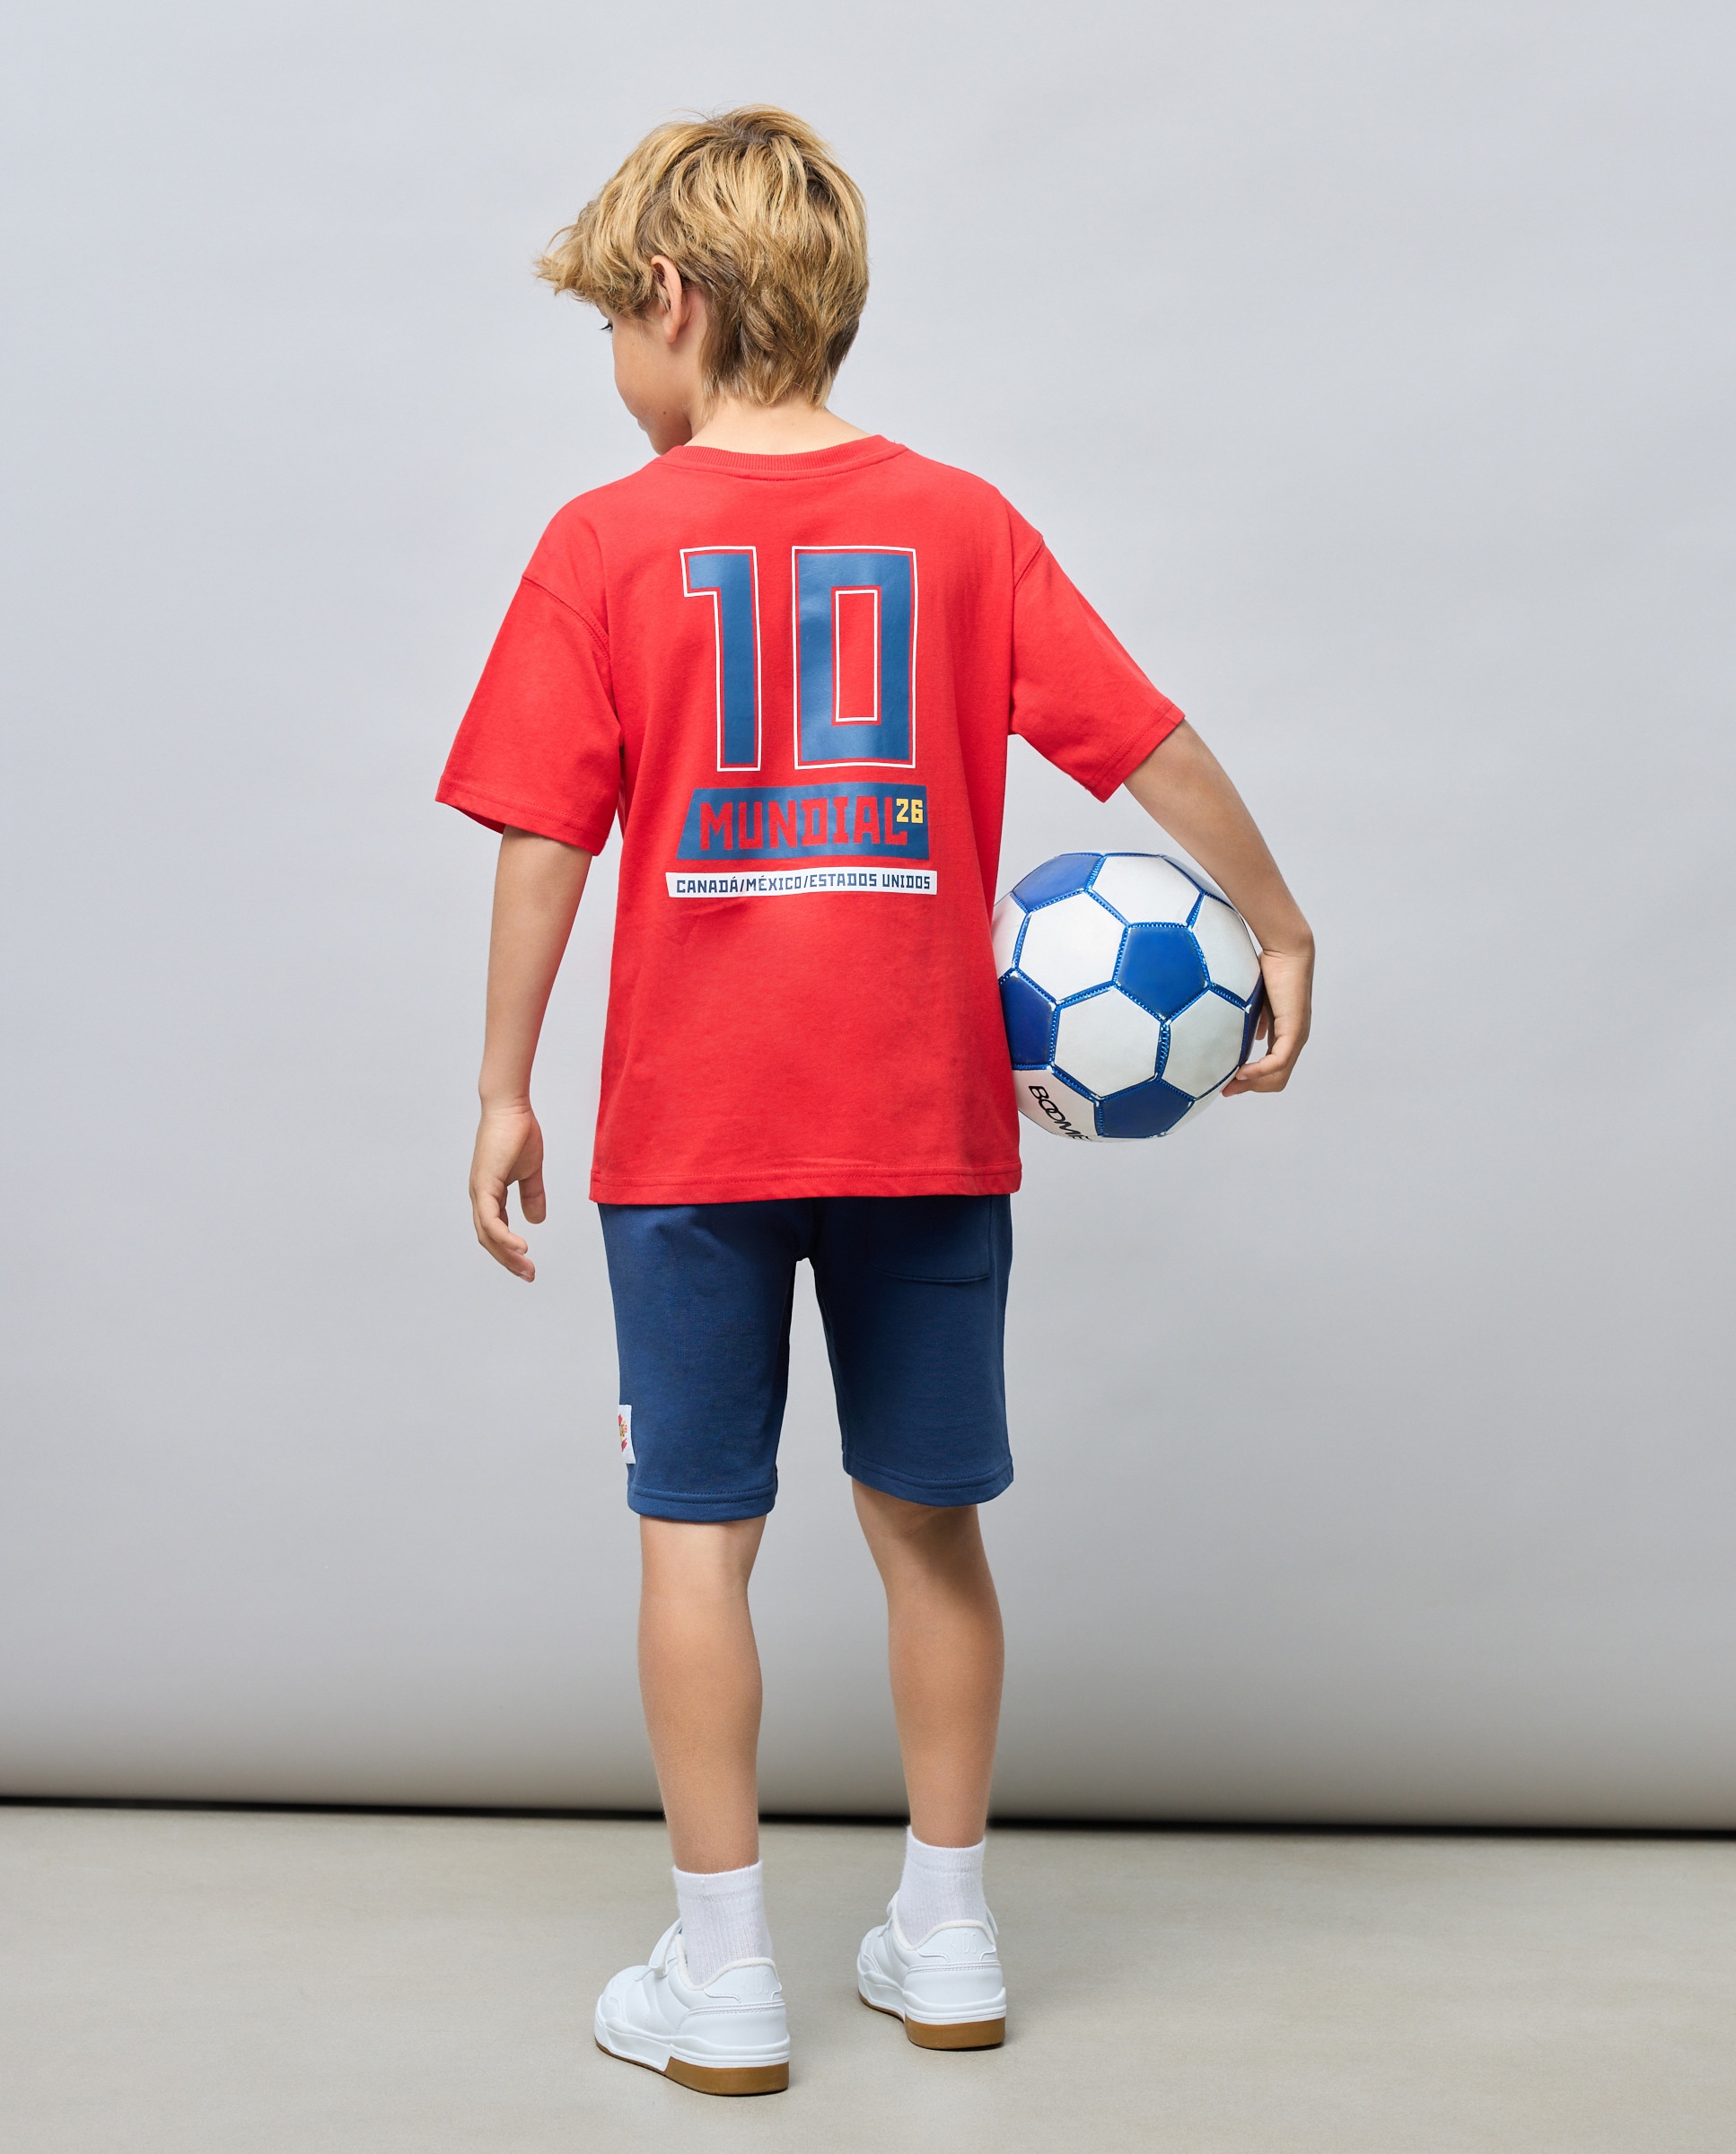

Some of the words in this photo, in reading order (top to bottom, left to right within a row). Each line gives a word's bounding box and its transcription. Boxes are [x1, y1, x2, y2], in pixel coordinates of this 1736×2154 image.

[679, 546, 918, 772] 10
[699, 796, 908, 851] MUNDIAL
[896, 798, 924, 824] 26
[881, 873, 931, 889] UNIDOS
